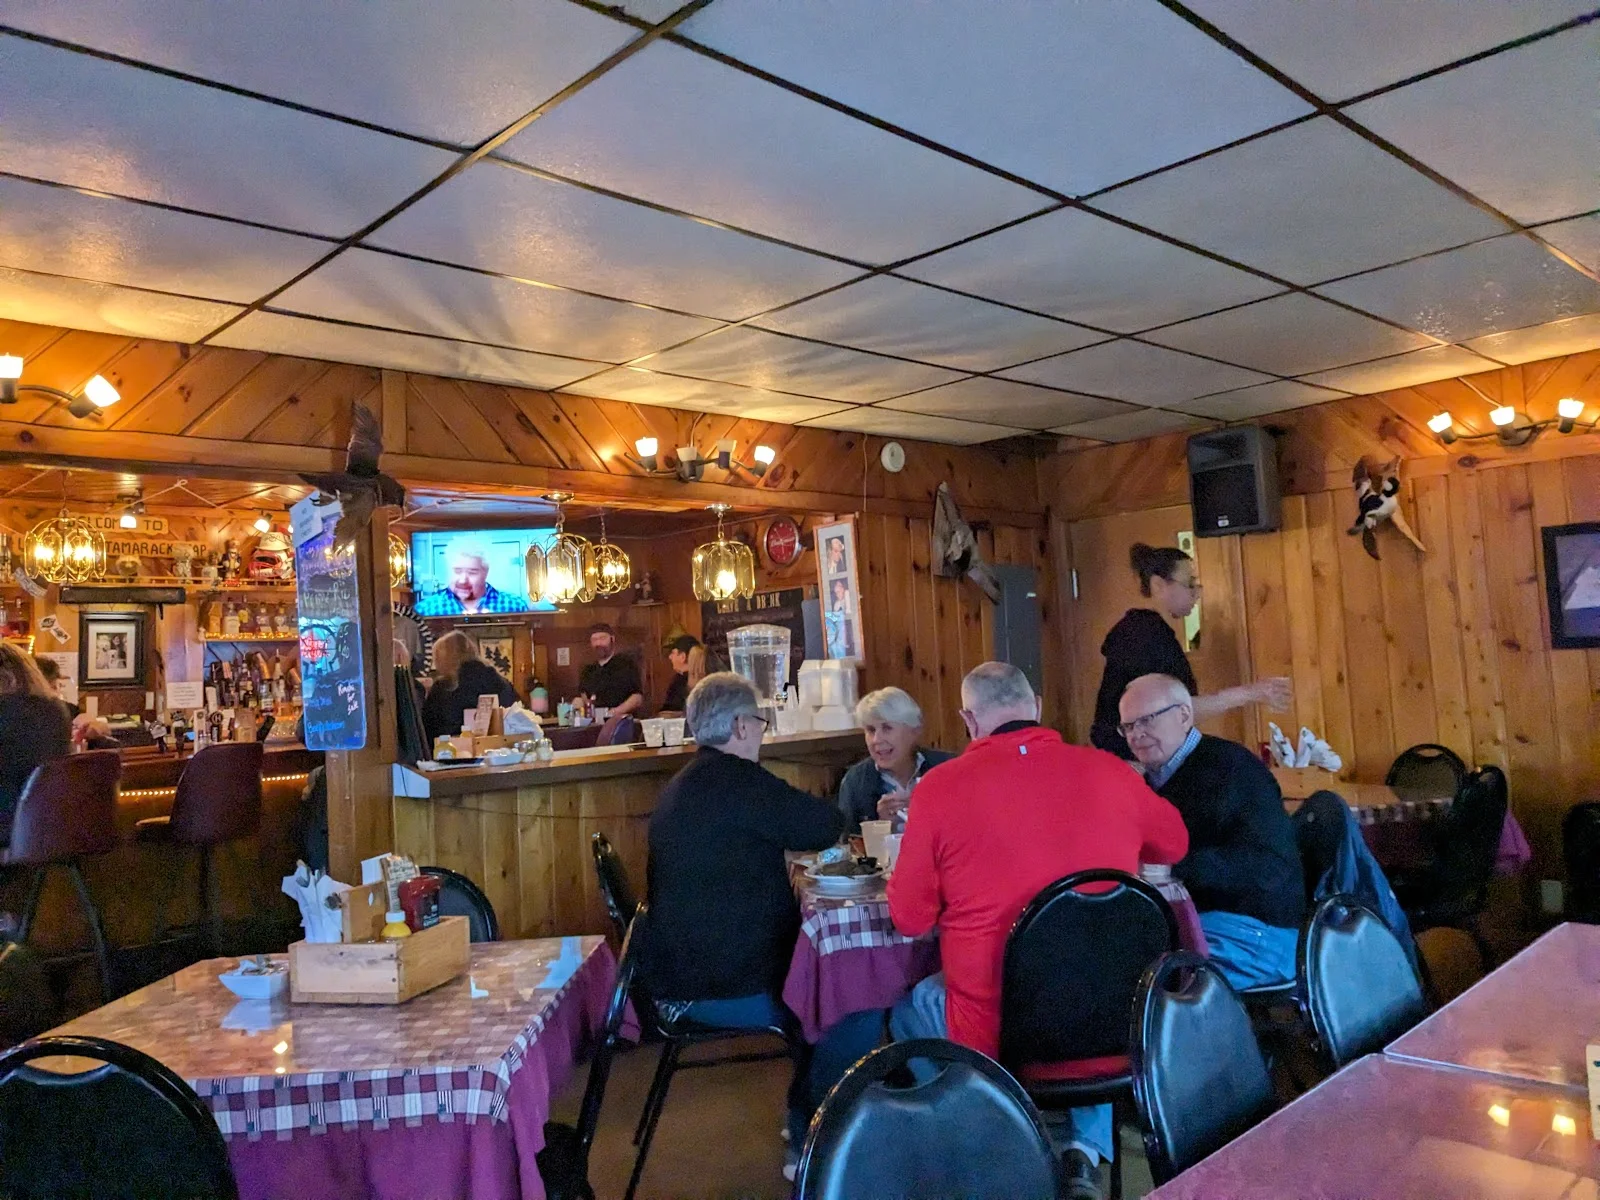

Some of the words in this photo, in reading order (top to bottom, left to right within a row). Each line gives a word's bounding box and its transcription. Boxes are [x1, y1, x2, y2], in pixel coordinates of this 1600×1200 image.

[67, 516, 126, 530] WELCOM
[144, 519, 163, 531] TO
[107, 541, 173, 556] TAMARACK
